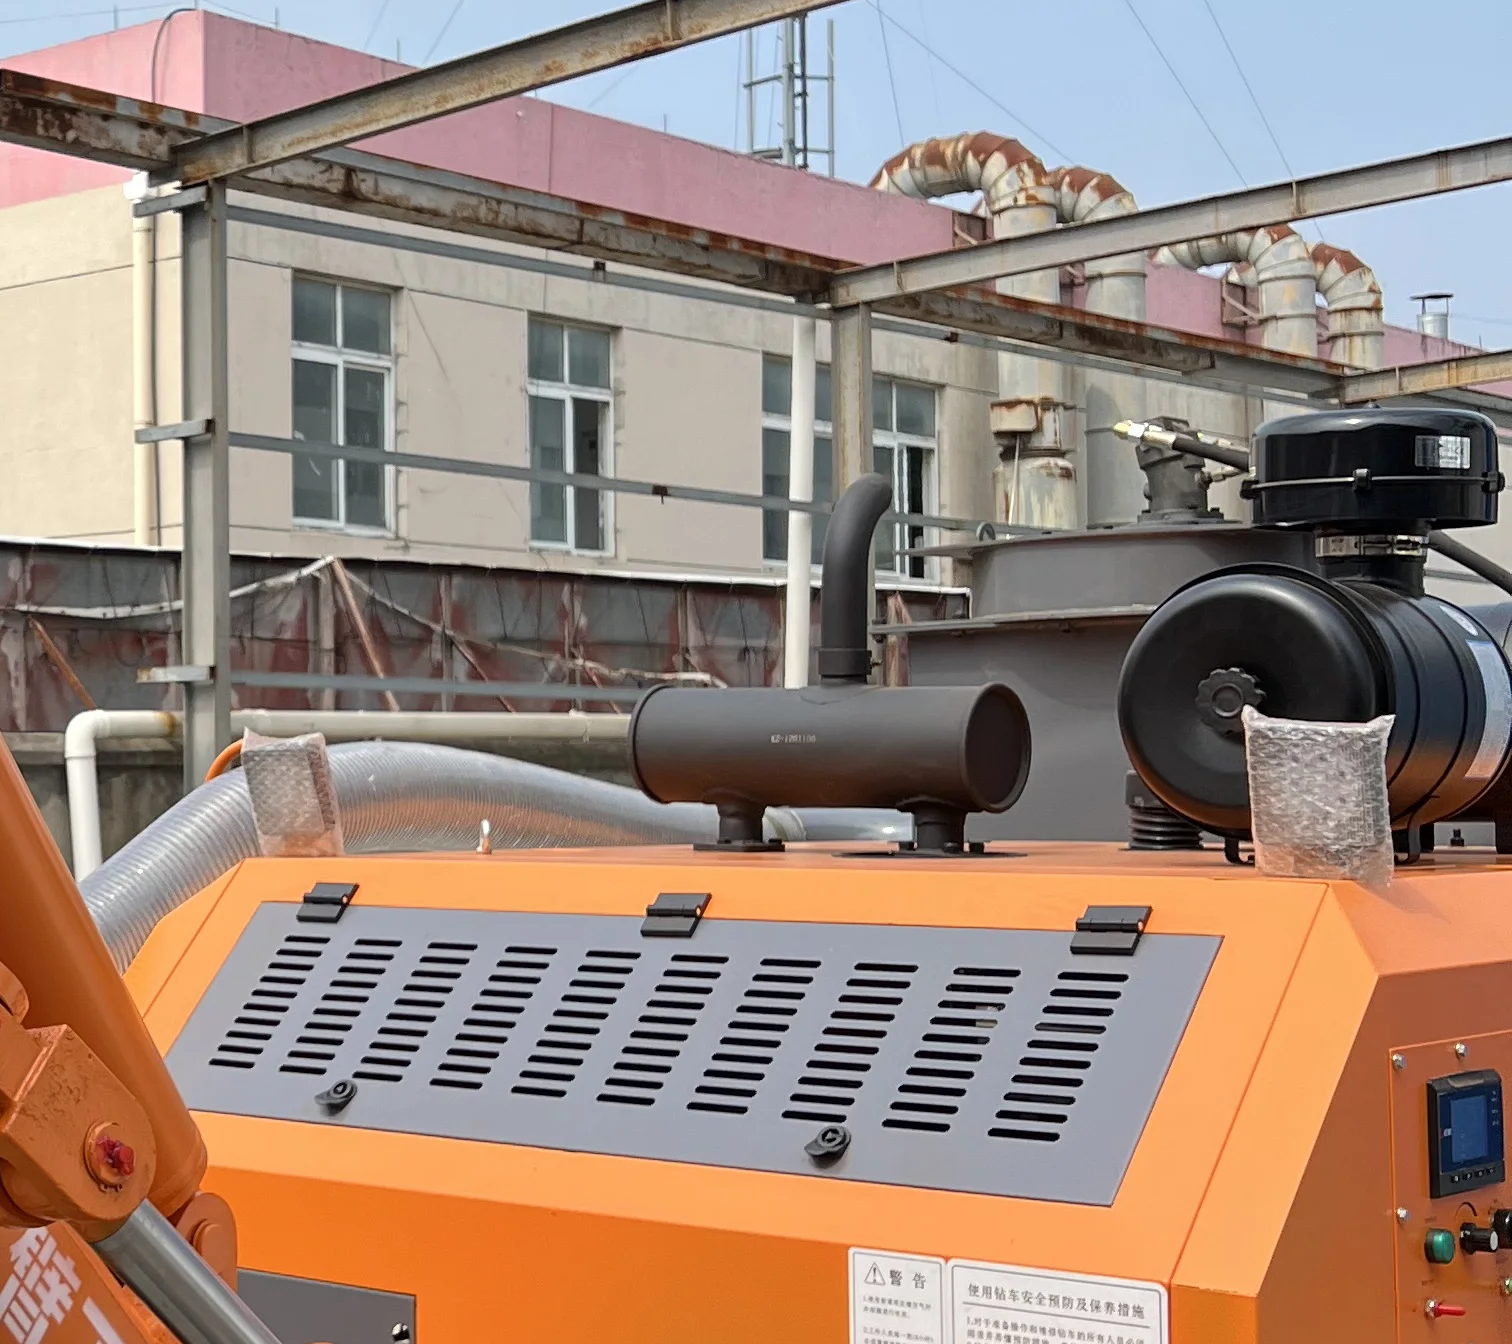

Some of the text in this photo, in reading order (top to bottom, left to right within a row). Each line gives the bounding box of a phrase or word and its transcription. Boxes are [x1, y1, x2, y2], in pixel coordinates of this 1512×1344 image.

[888, 1268, 928, 1290] 警告
[967, 1281, 1144, 1320] 使用钻车安全预防及保养措施
